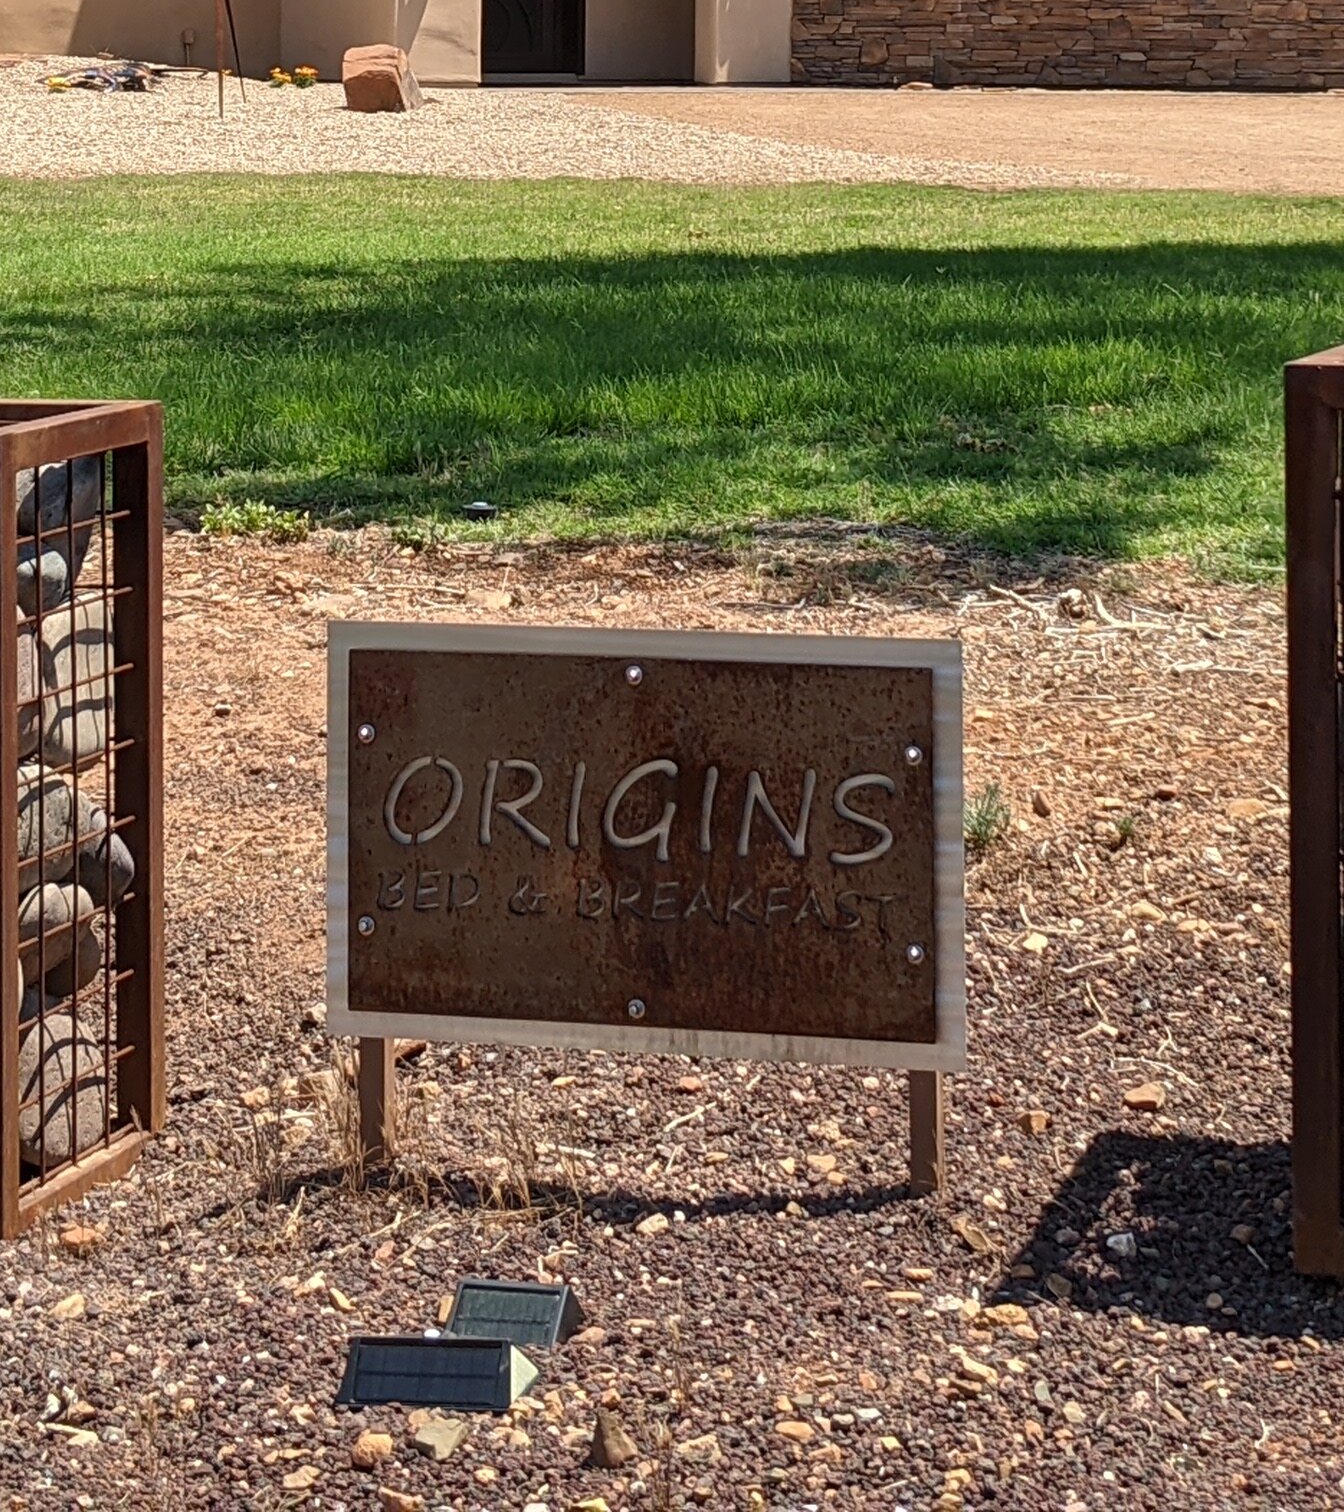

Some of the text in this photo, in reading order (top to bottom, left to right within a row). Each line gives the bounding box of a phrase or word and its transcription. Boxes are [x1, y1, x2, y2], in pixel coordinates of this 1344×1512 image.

[383, 755, 897, 866] ORIGINS
[376, 869, 895, 934] BED & BREAKFAST
